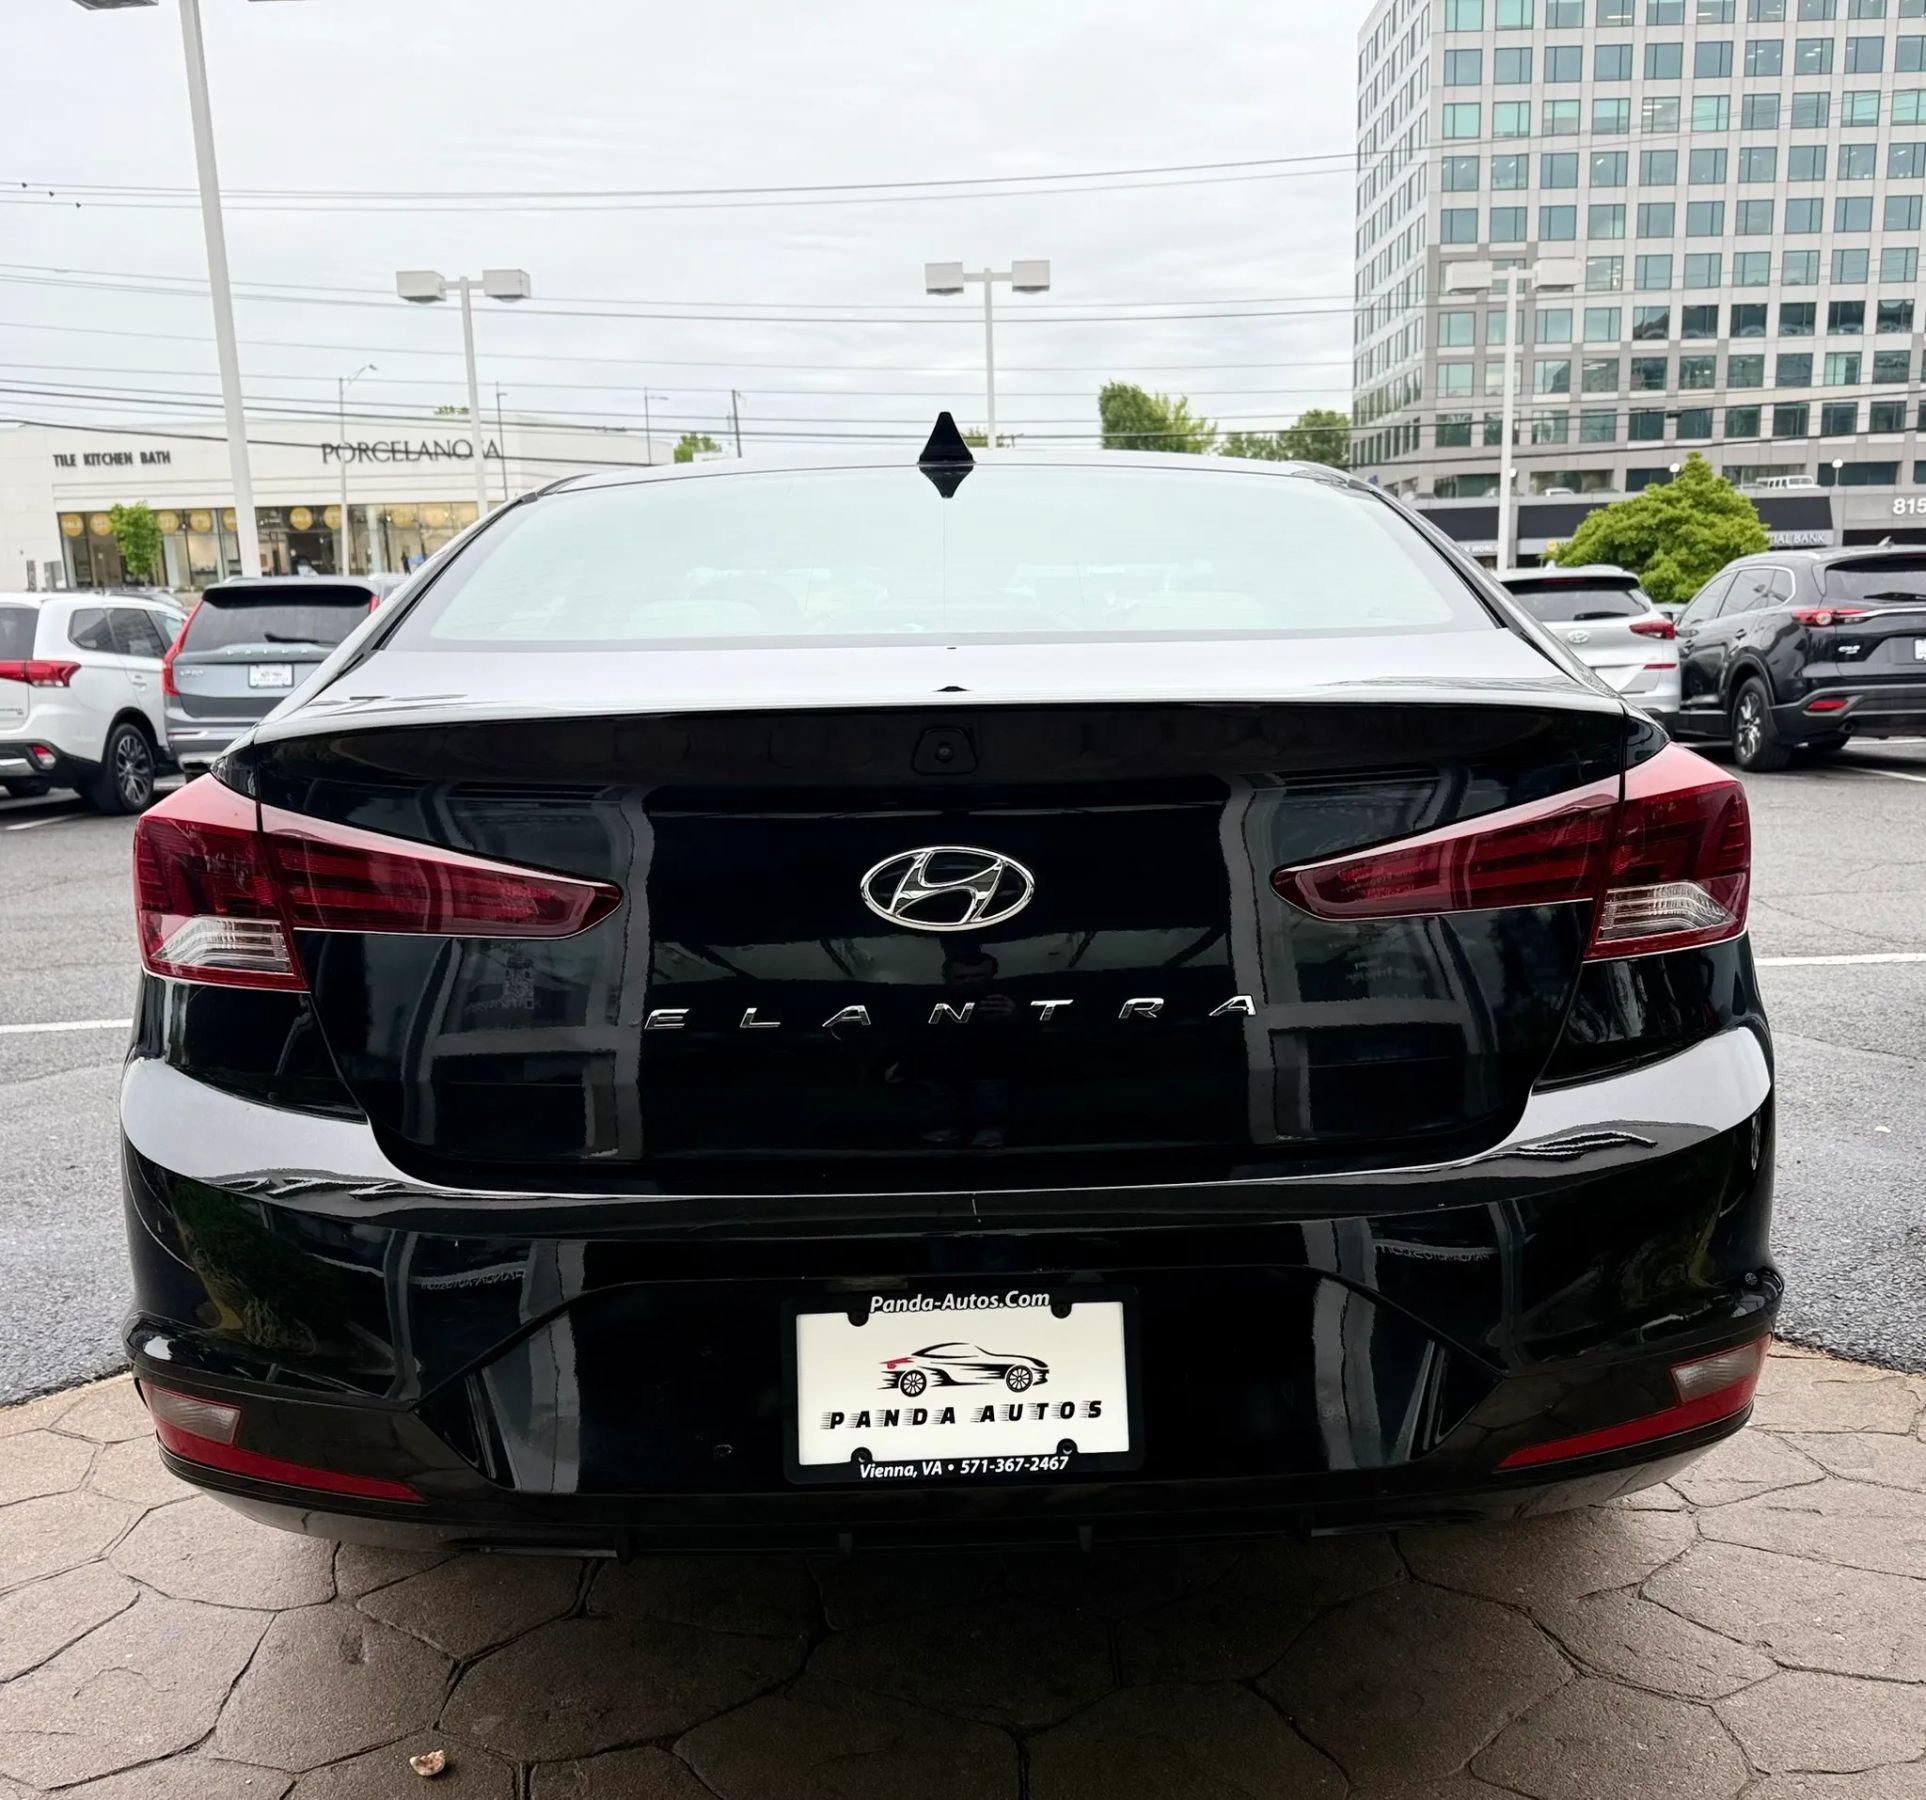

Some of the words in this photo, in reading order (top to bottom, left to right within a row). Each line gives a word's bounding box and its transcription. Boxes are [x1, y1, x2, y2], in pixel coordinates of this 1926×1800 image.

[53, 454, 76, 467] TILE
[83, 452, 133, 466] KITCHEN
[140, 450, 171, 464] BATH
[320, 438, 501, 464] PORCELANOA
[1892, 497, 1926, 515] 815
[1794, 531, 1825, 544] BANK
[645, 995, 1257, 1029] ELANTRA
[870, 1290, 1050, 1313] Panda-Autos.Com
[821, 1407, 956, 1429] PANDA
[970, 1400, 1102, 1423] AUTOS
[859, 1461, 918, 1479] Vienna,
[922, 1460, 943, 1476] VA
[960, 1456, 1070, 1474] 571-367-2467
